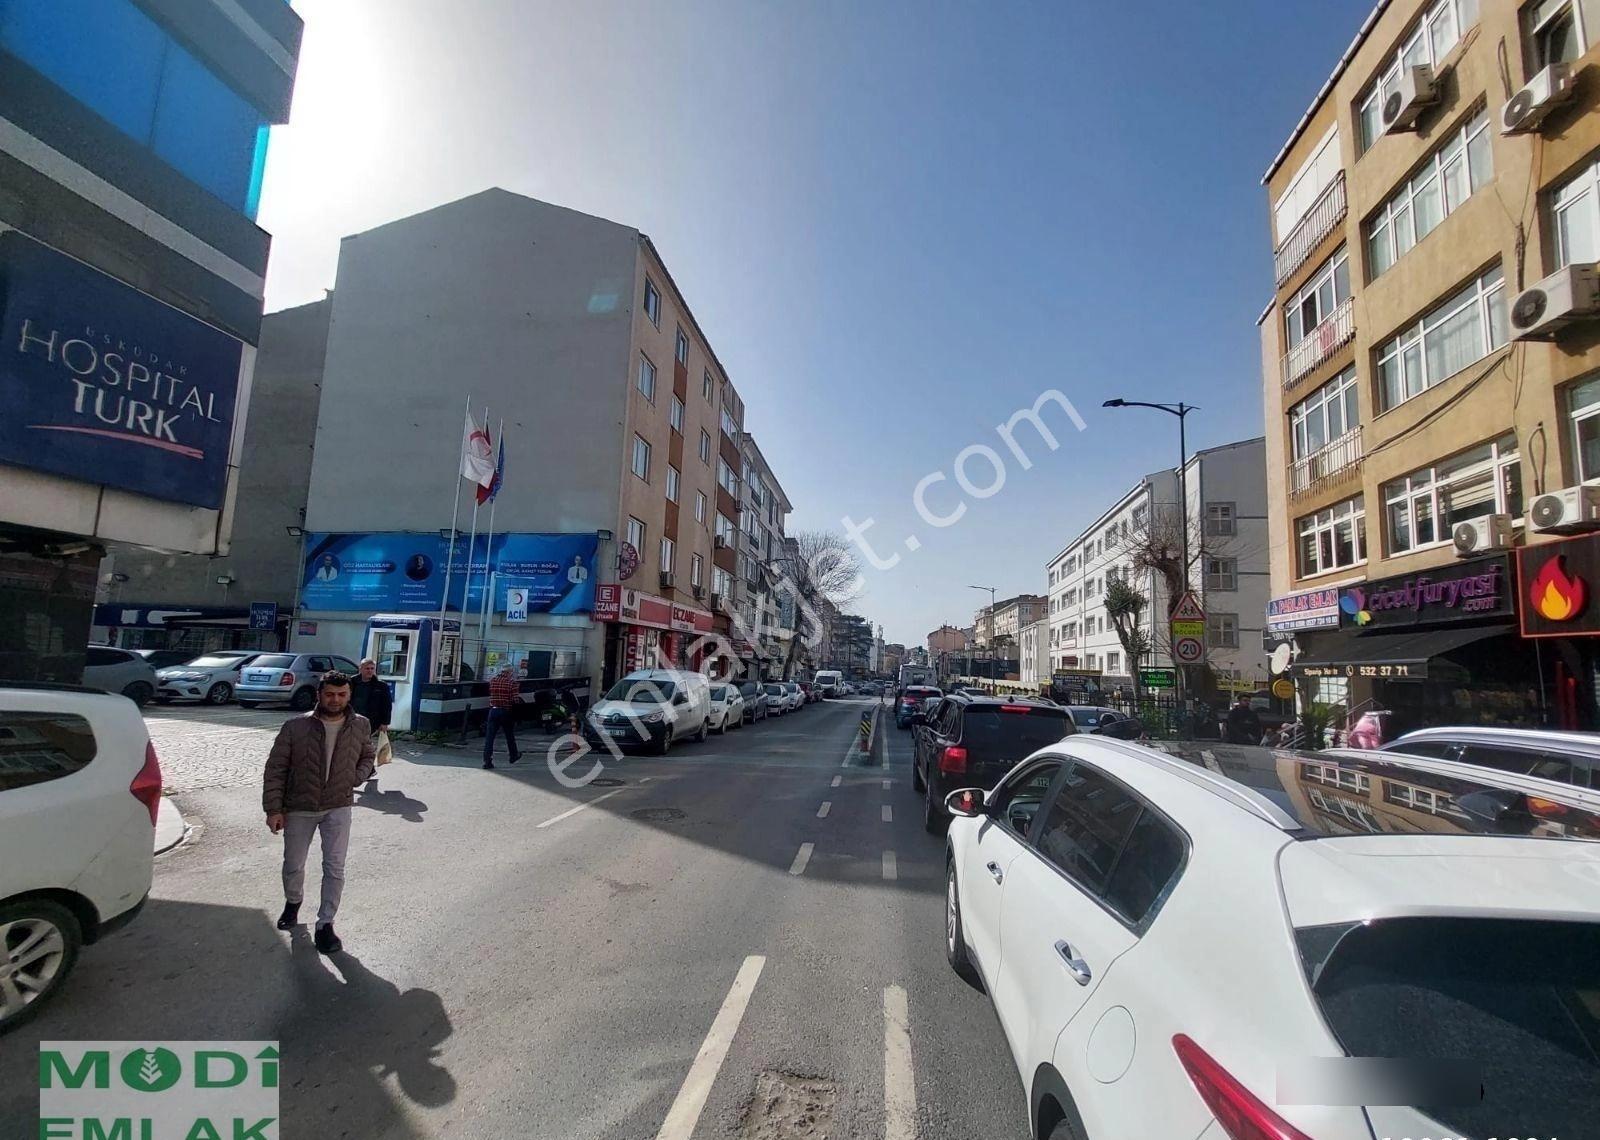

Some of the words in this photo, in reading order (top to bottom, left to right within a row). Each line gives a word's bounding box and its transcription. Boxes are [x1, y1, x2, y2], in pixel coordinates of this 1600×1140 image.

[20, 319, 221, 423] HOSPITAL
[1308, 589, 1337, 609] EMLAK
[508, 609, 526, 619] ACİL
[1182, 643, 1197, 655] 20
[1360, 666, 1377, 676] 532
[1380, 666, 1391, 676] 37
